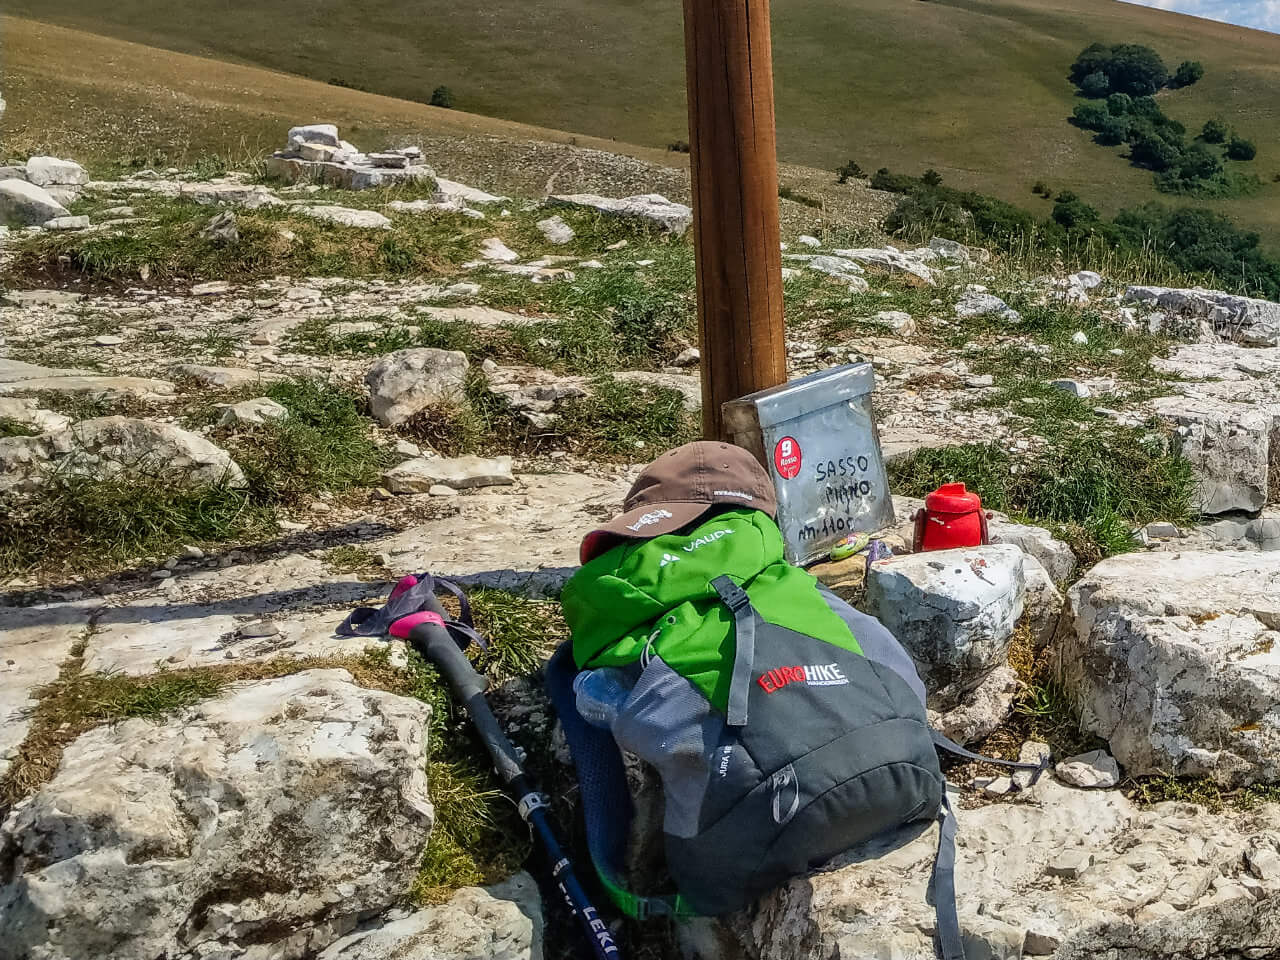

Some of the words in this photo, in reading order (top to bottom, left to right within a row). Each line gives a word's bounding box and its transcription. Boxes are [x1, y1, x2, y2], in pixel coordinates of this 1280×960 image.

[781, 440, 792, 457] 9
[816, 455, 868, 482] SASSO
[757, 662, 845, 694] EUROHIKE
[719, 755, 730, 777] JURA
[582, 906, 618, 954] LEKI
